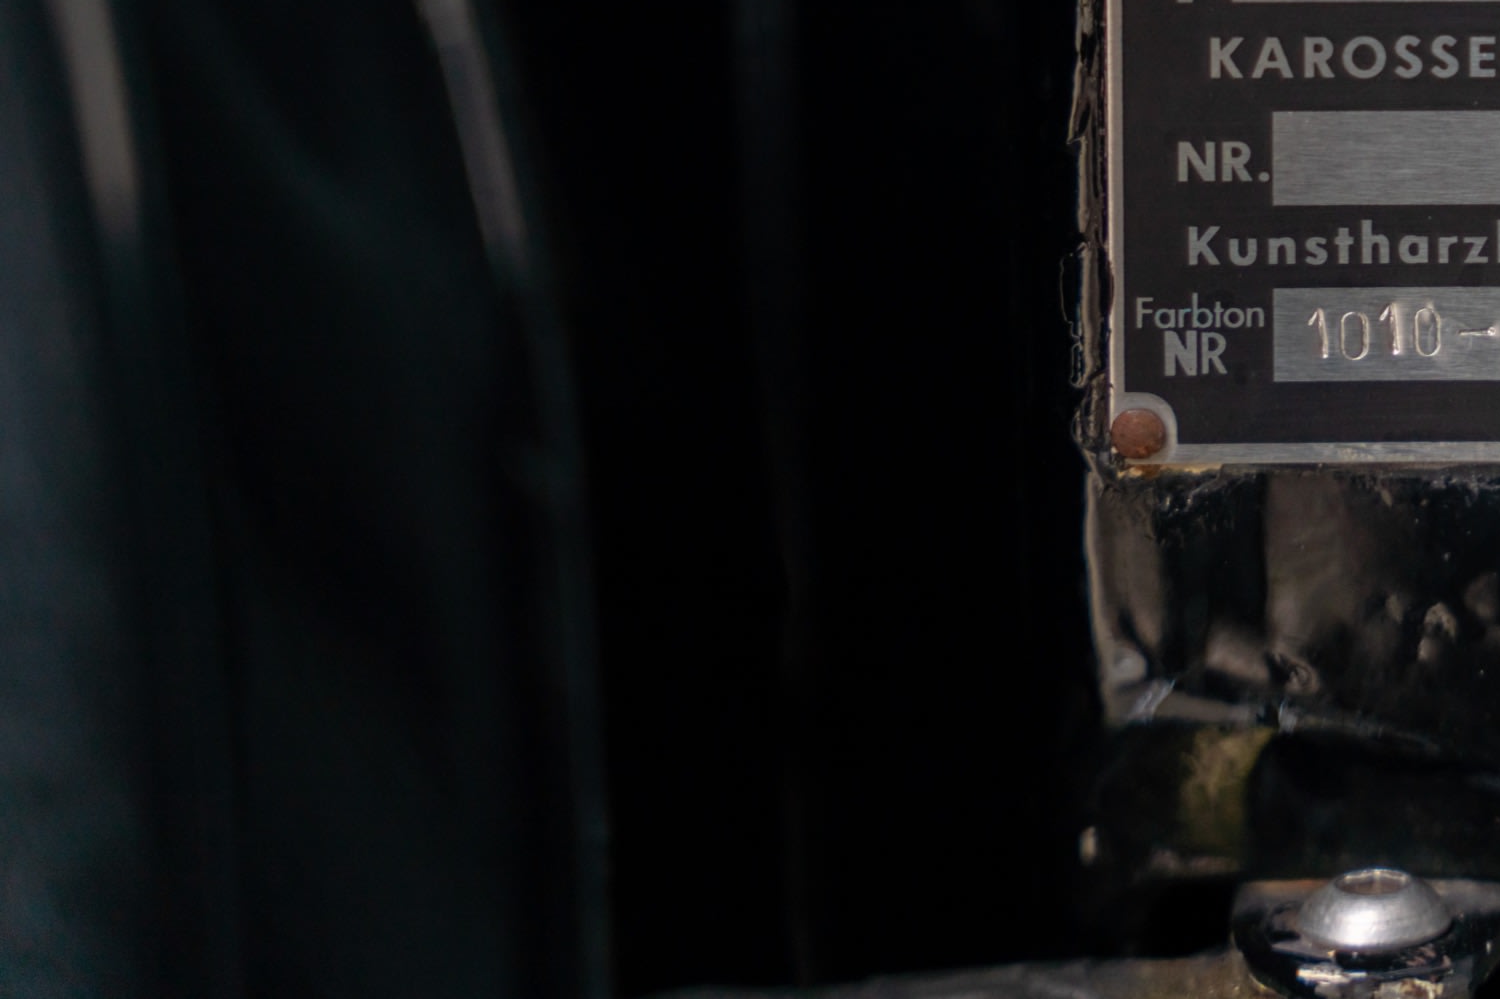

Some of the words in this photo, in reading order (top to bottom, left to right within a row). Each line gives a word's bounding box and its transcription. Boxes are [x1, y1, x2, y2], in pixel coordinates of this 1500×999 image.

[1177, 141, 1271, 183] NR.
[1135, 293, 1265, 330] Farbton
[1163, 331, 1228, 377] NR
